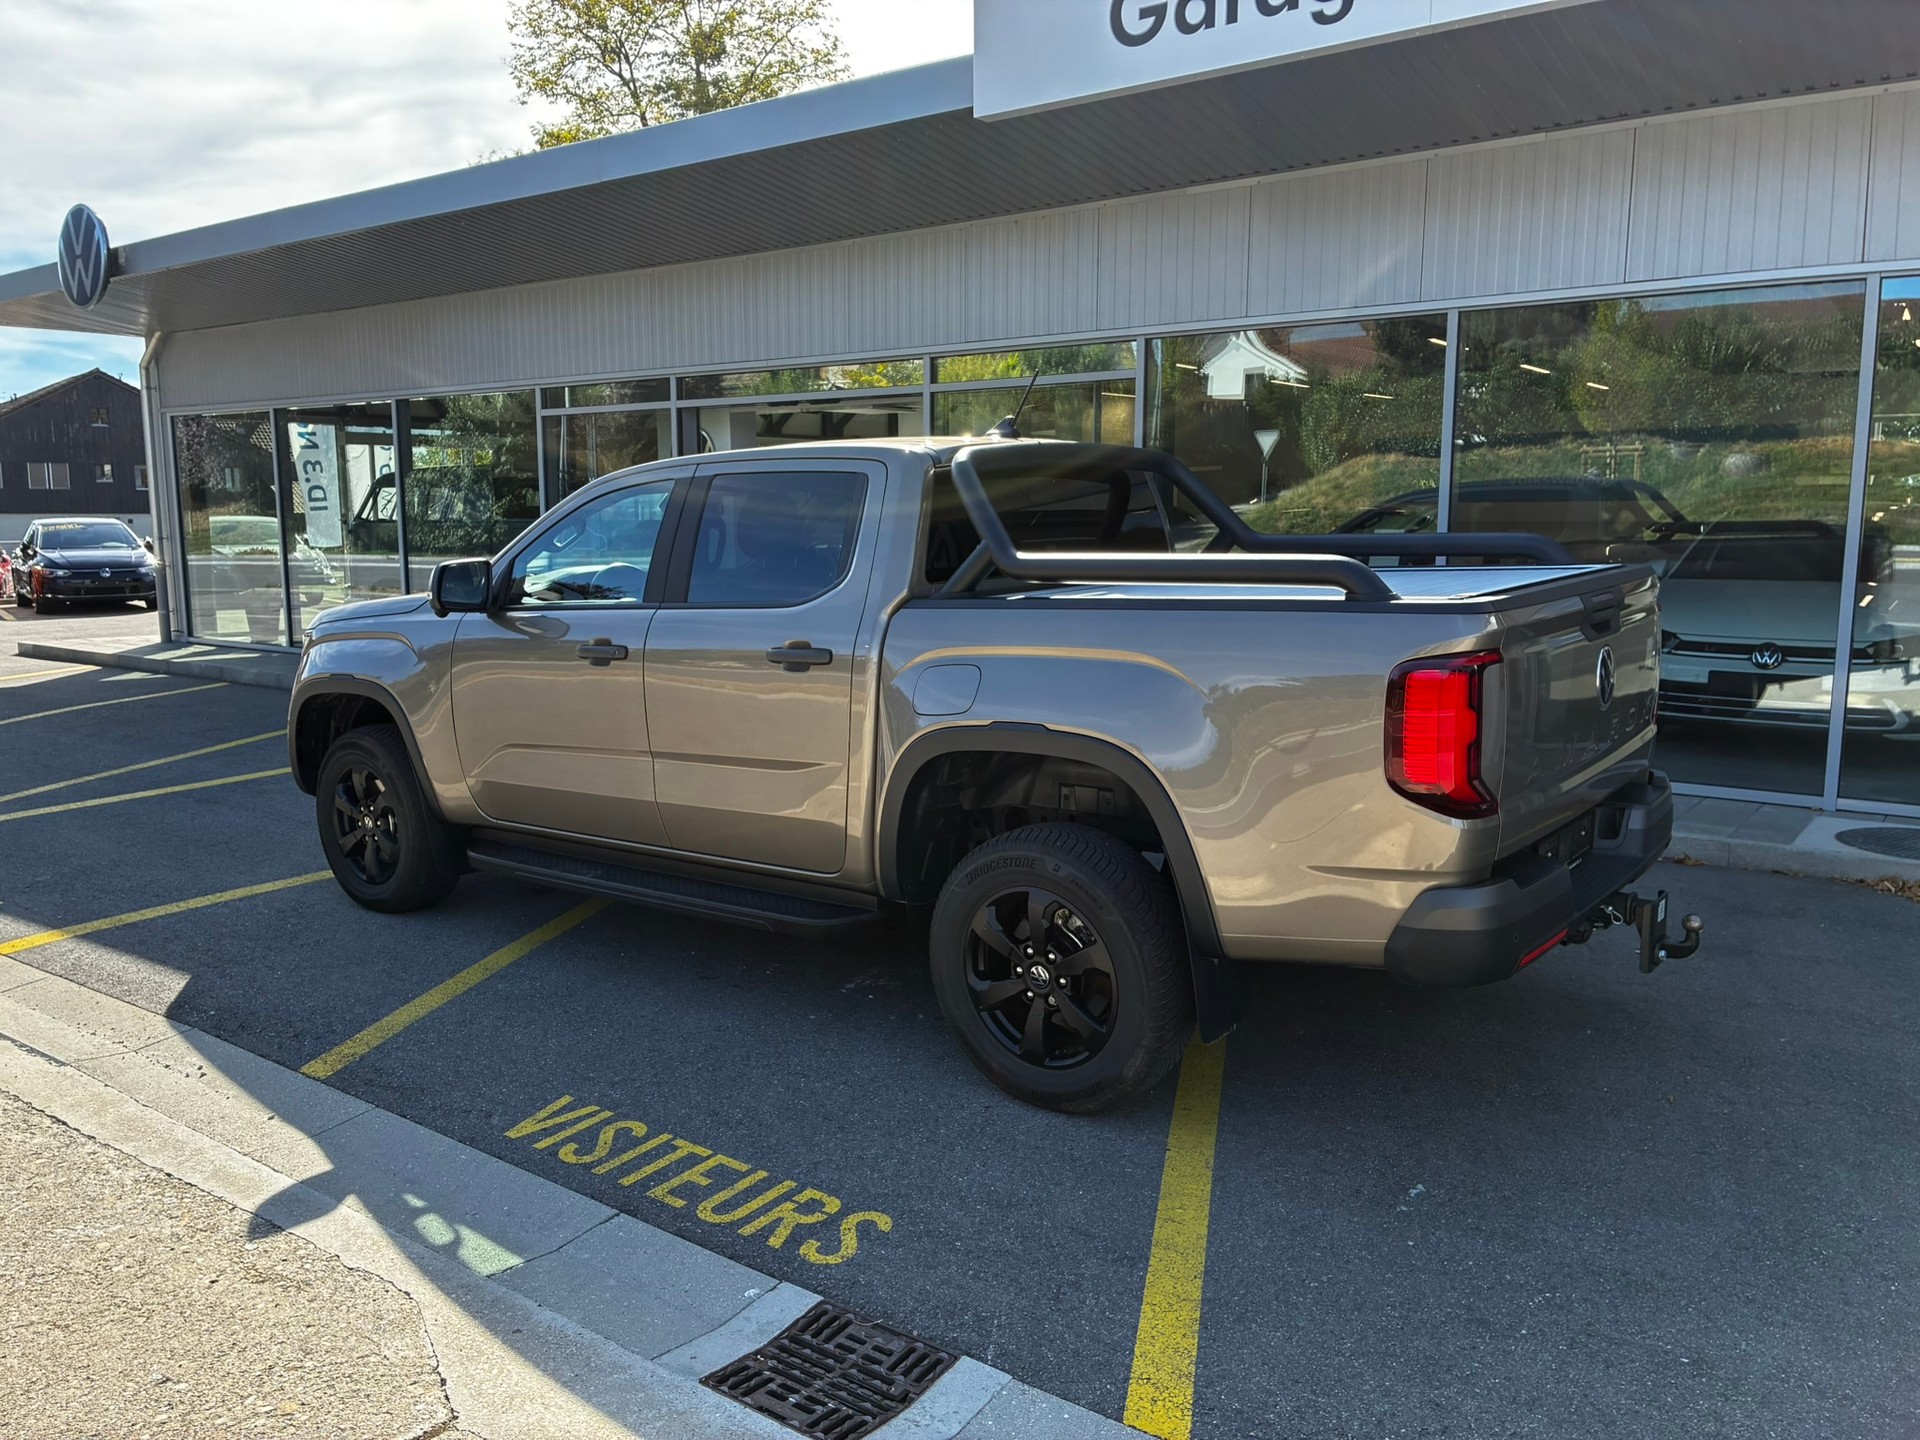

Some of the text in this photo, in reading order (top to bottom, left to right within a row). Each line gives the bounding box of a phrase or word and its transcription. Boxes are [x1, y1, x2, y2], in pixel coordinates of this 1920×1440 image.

[59, 206, 108, 307] VW
[966, 856, 1038, 886] BRIDGESTONE
[504, 1094, 893, 1265] VISITEURS
